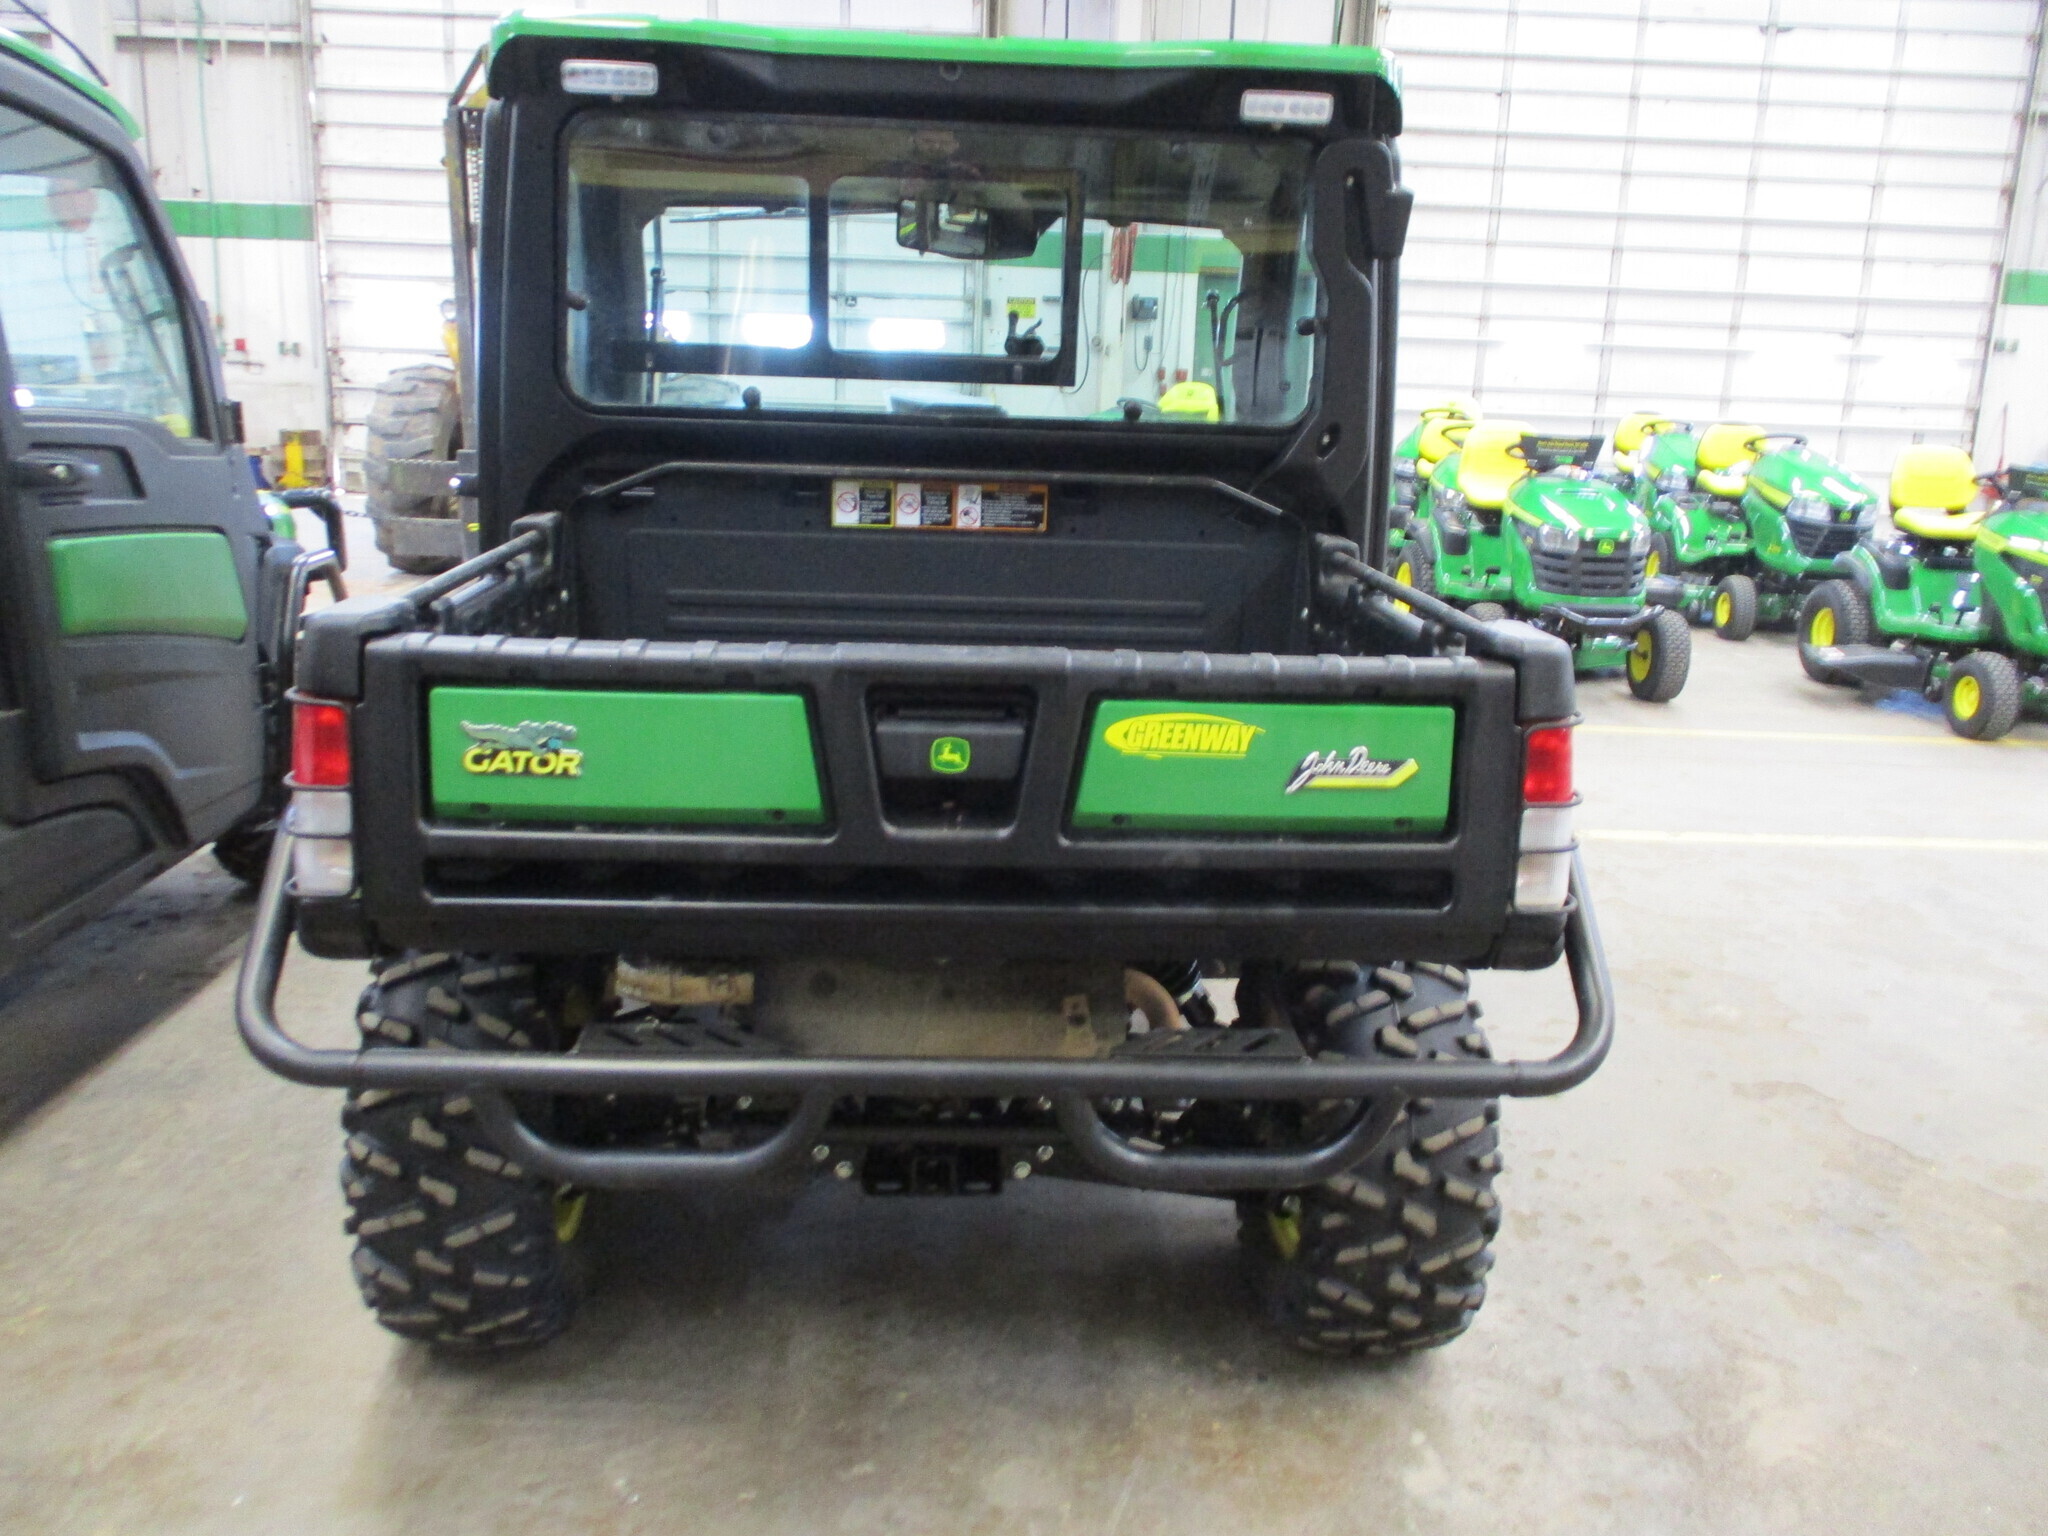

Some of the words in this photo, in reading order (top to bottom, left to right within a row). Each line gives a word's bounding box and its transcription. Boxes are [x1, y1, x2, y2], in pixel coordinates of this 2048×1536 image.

[1125, 720, 1257, 753] GREENWAY
[463, 747, 582, 775] GATOR
[1285, 750, 1346, 795] John
[1343, 745, 1392, 775] Deere
